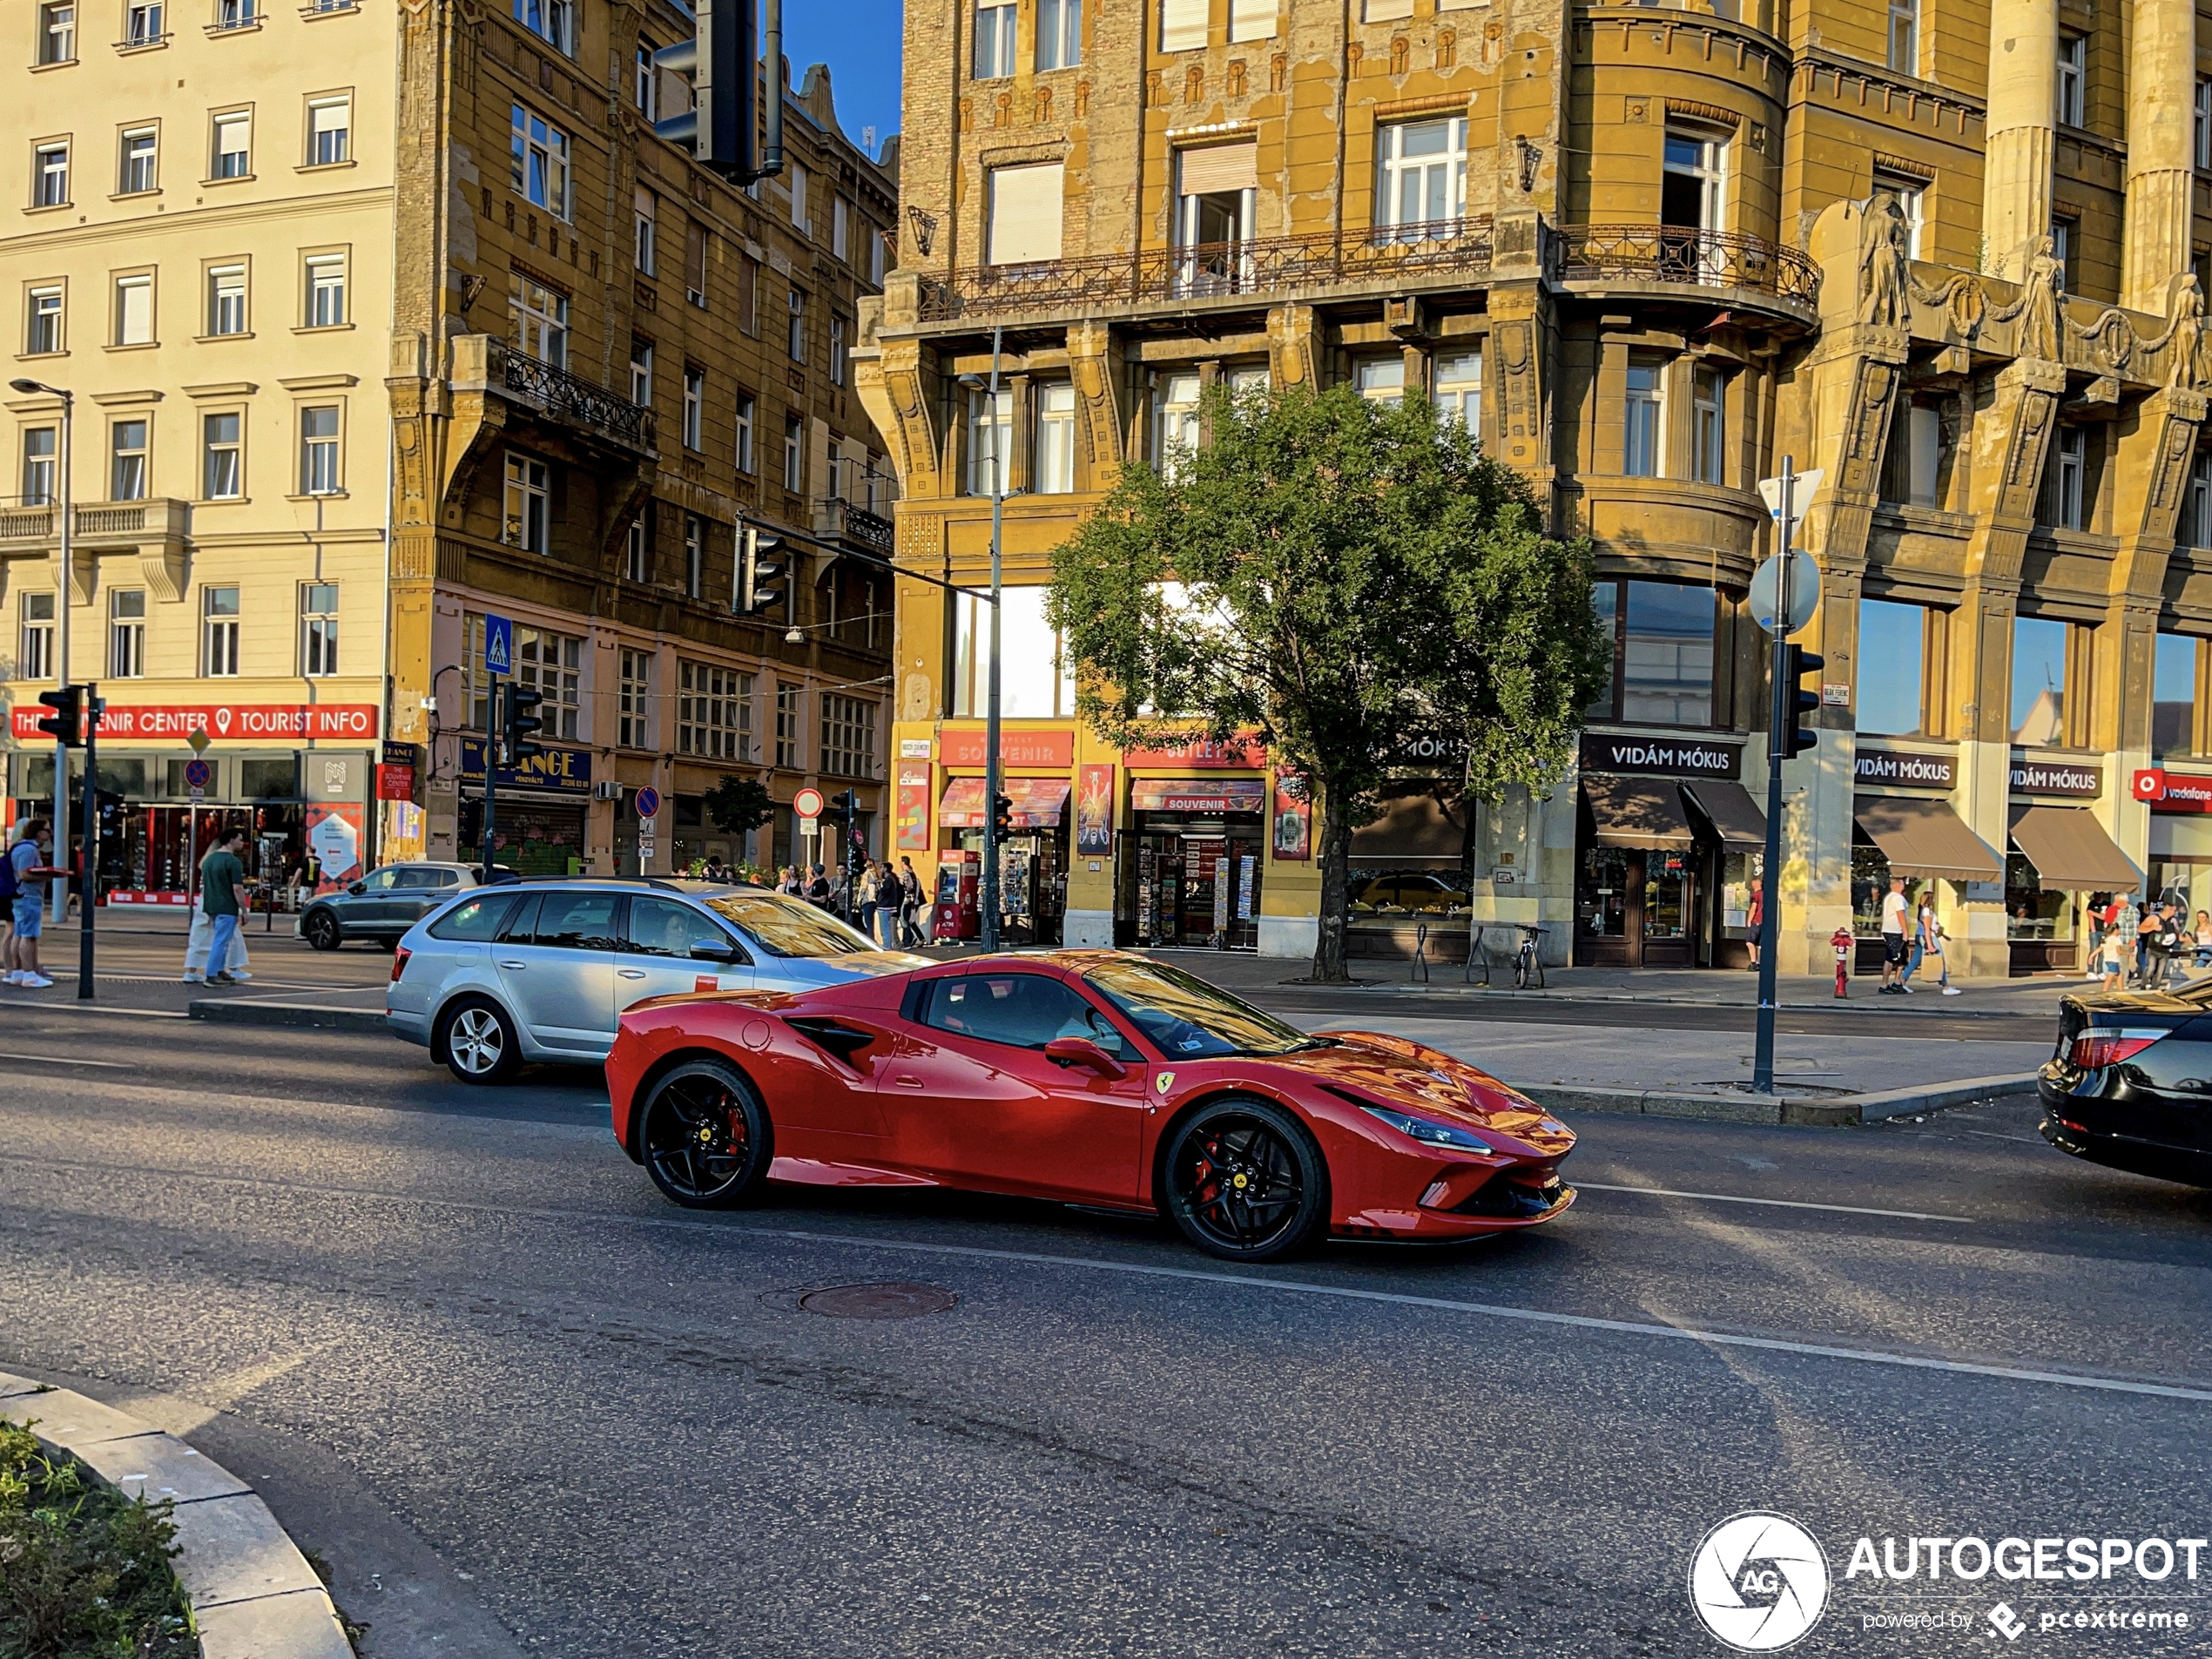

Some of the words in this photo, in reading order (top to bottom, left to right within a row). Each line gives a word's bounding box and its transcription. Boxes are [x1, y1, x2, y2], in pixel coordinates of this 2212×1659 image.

[51, 712, 134, 732] ENIR
[139, 712, 208, 732] CENTER
[240, 711, 313, 732] TOURIST
[320, 711, 368, 732] INFO
[958, 745, 1054, 761] SOVENIR
[1611, 744, 1673, 765] VIDÁM
[1677, 746, 1730, 770] MÓKUS
[1899, 759, 1951, 780] MÓKUS
[2049, 768, 2096, 790] MÓKUS
[2168, 786, 2212, 800] vodafone
[1169, 799, 1225, 809] SOUVENIR
[972, 816, 1025, 826] BUST
